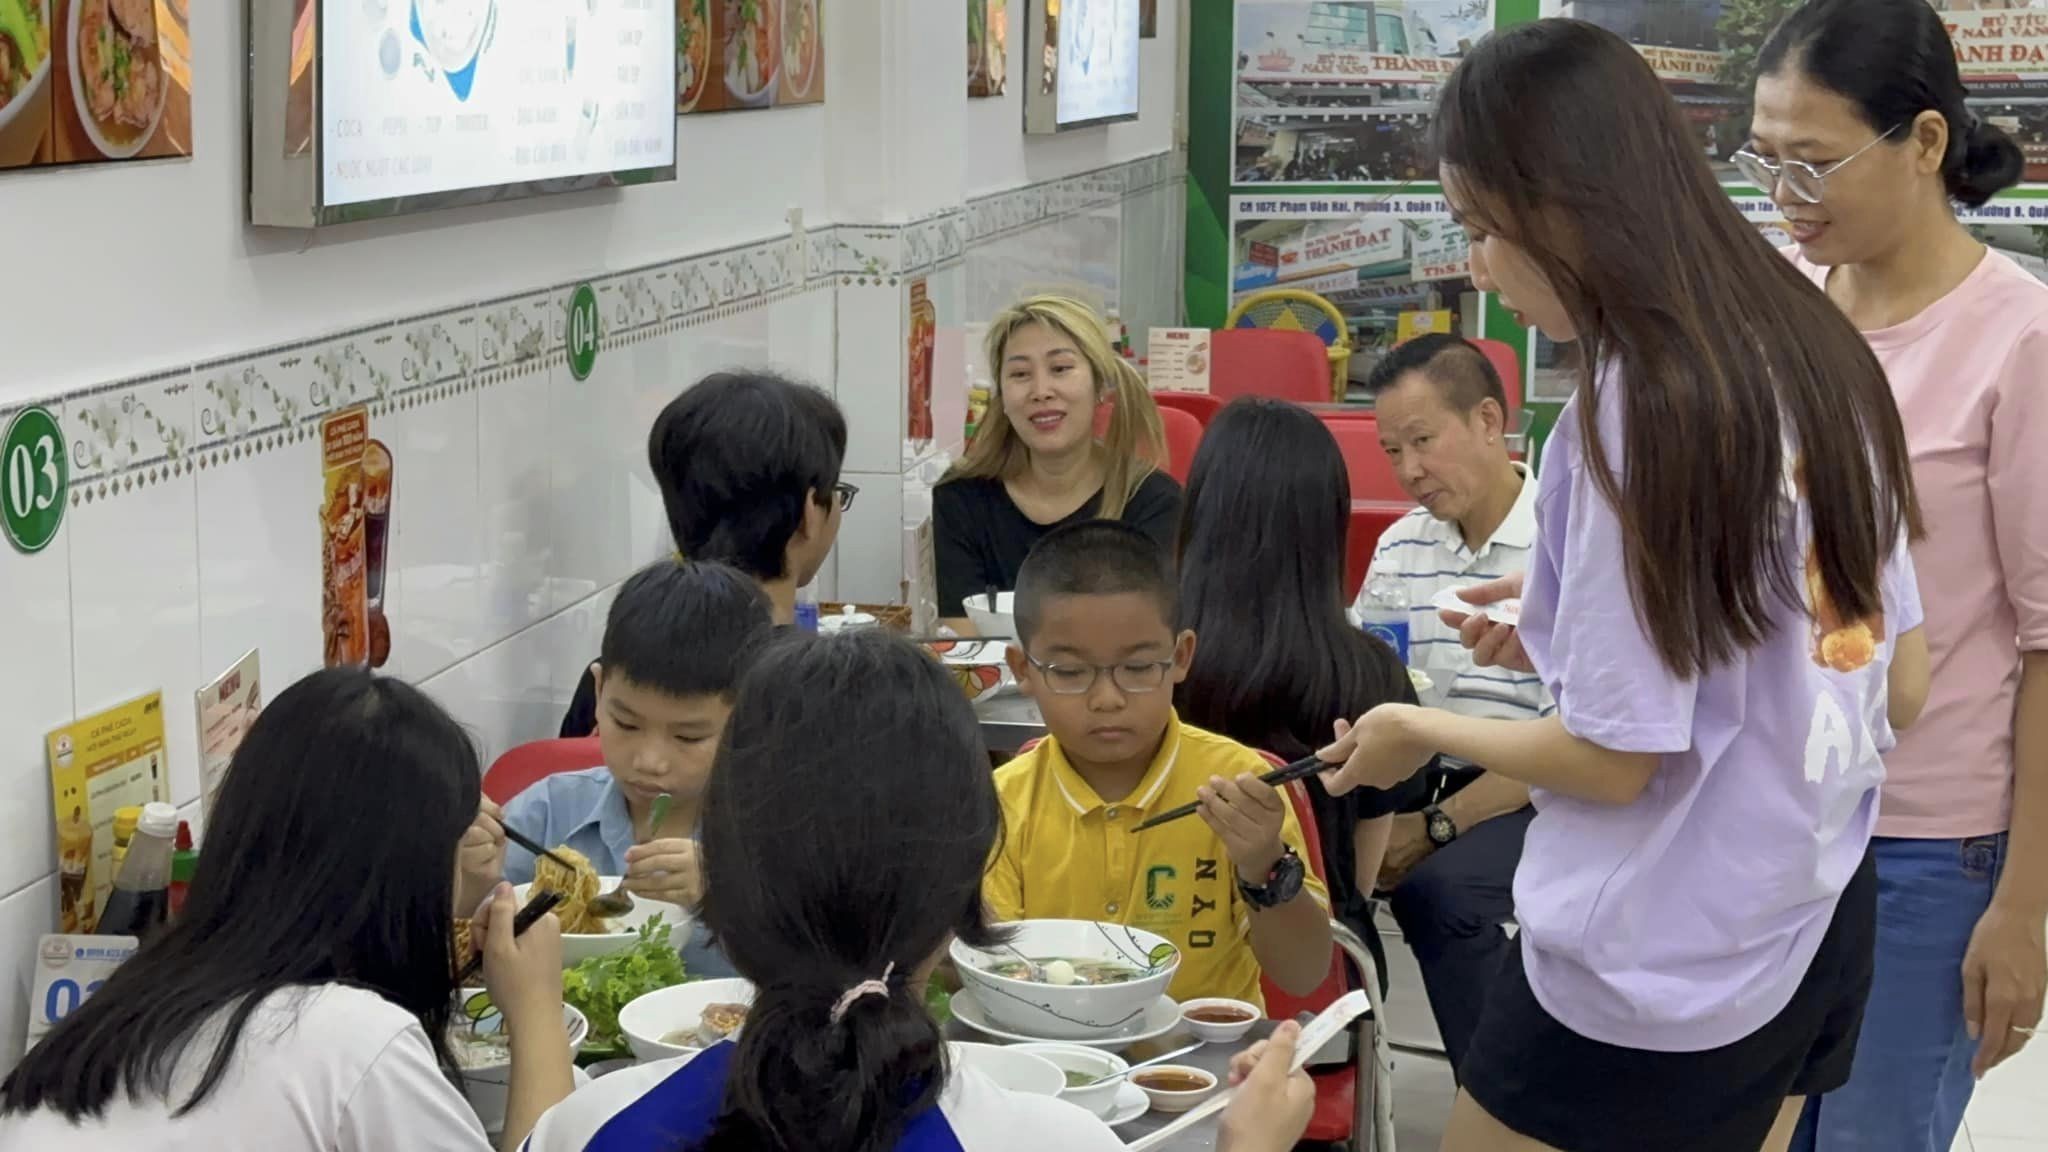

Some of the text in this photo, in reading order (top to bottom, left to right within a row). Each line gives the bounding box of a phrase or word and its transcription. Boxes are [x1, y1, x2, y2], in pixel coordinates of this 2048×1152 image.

[1962, 26, 2048, 38] NAM VAN
[1955, 40, 2048, 65] ÀNH ĐẠ
[1302, 63, 1333, 74] NAM
[1370, 54, 1438, 73] THÀNH
[336, 118, 363, 138] COCA
[1280, 201, 1307, 213] Phạm
[1406, 201, 1433, 214] Quận
[1354, 227, 1392, 250] ĐẠT
[572, 302, 596, 356] 04
[8, 434, 60, 519] 03
[1146, 865, 1176, 909] C
